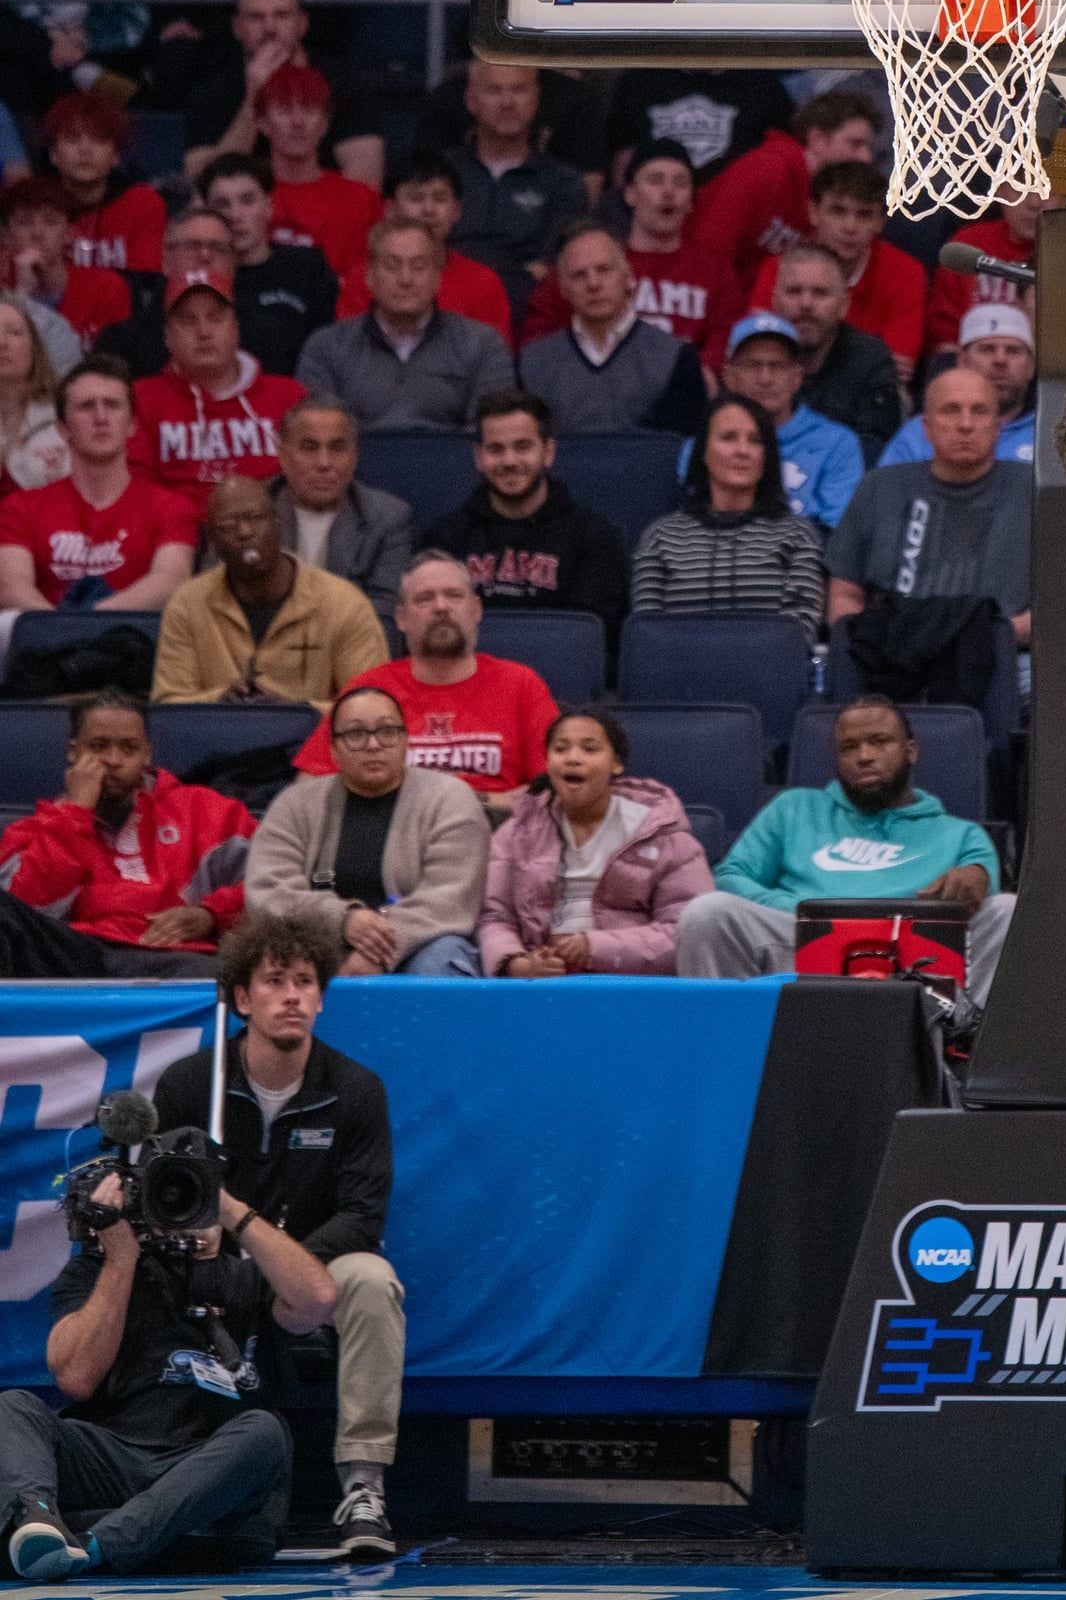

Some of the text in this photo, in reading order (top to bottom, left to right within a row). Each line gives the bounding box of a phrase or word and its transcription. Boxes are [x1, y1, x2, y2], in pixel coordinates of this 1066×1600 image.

[636, 277, 707, 319] AMI
[158, 416, 278, 462] MIAMI
[831, 836, 906, 866] NIKE
[917, 1248, 972, 1266] NCAA
